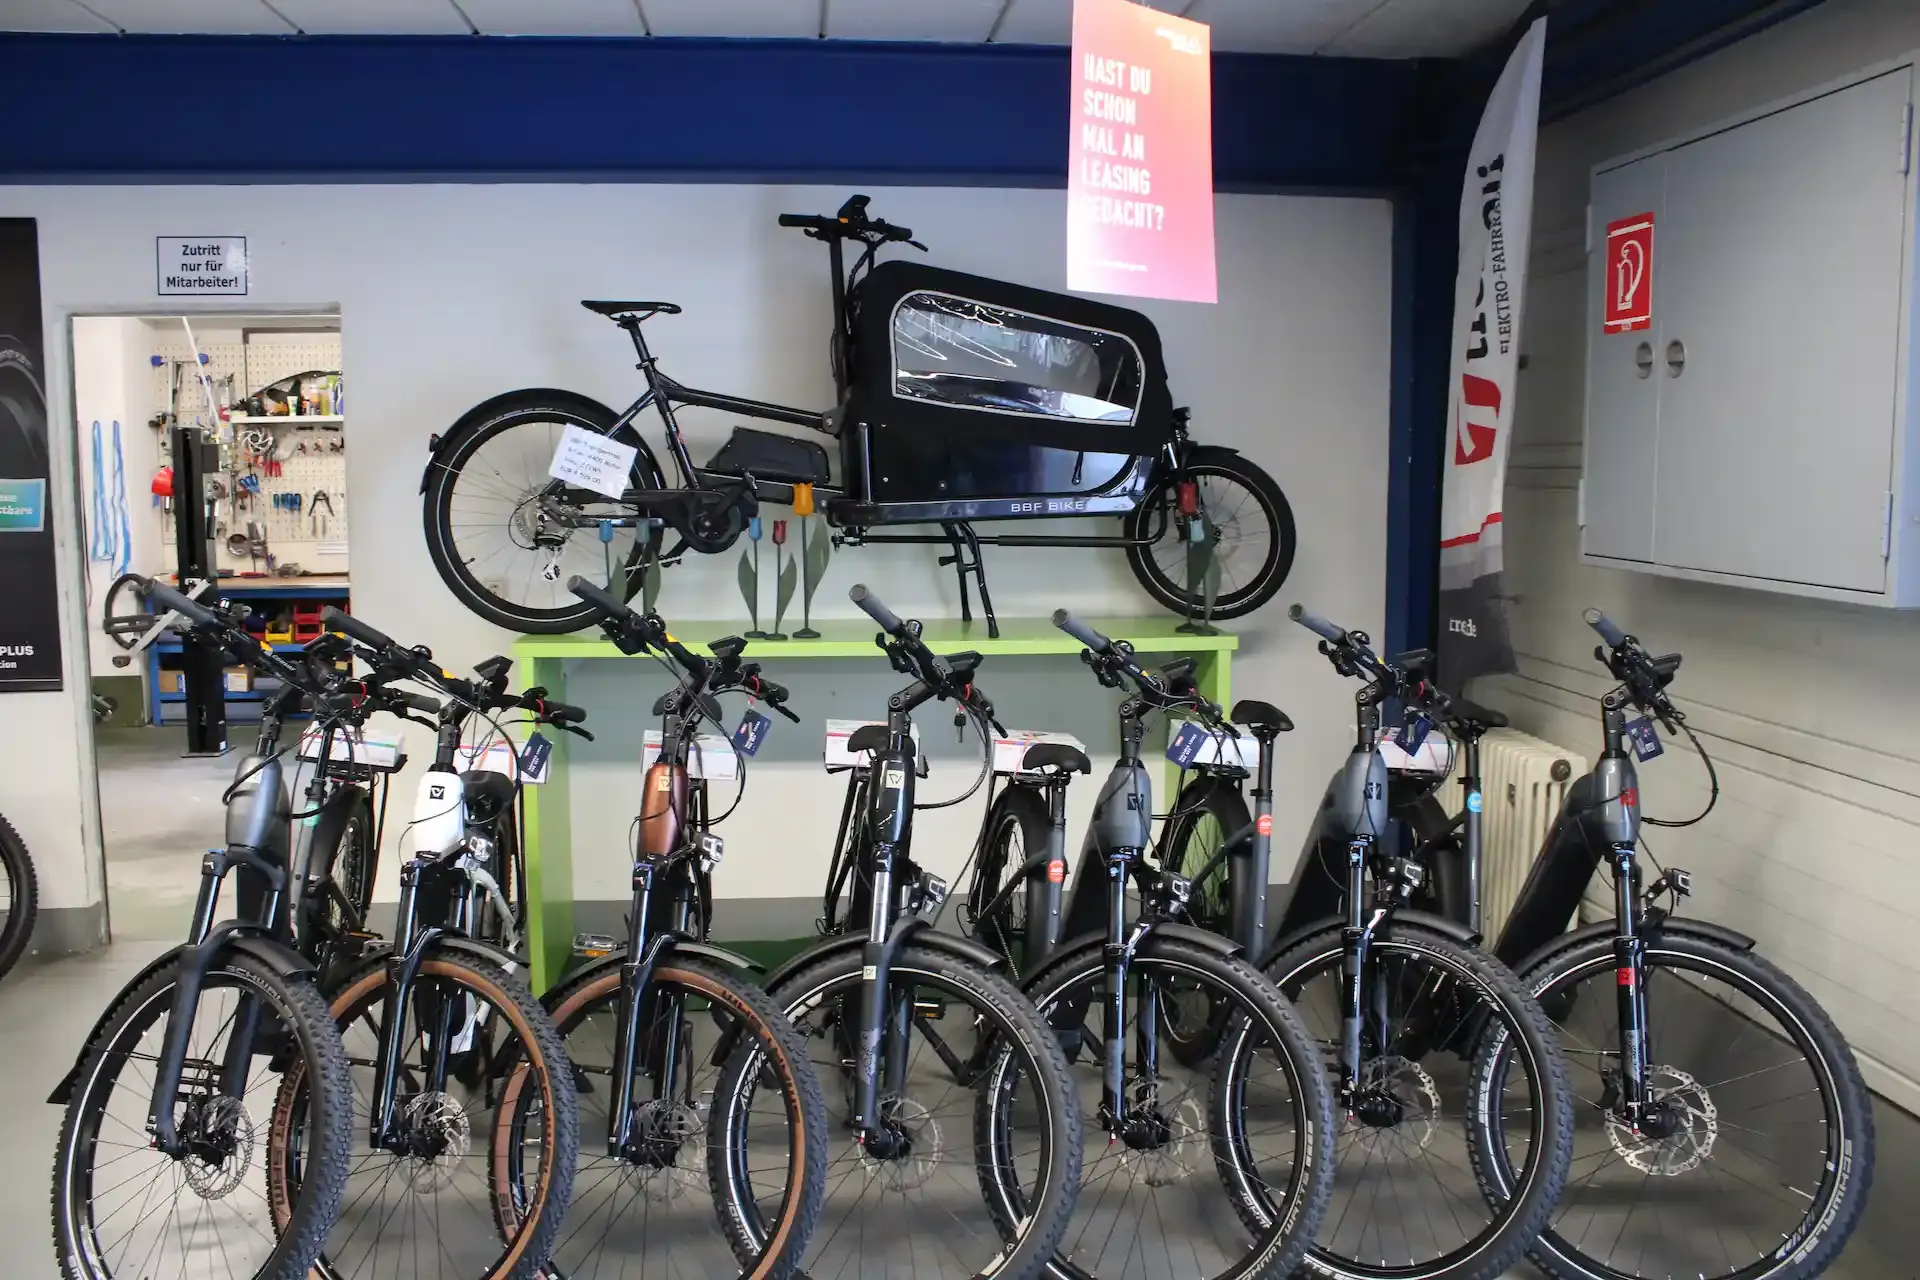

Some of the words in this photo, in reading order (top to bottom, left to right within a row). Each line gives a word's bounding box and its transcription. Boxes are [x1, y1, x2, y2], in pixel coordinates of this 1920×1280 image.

[1084, 53, 1126, 90] HAST
[1129, 65, 1151, 95] DU
[1083, 88, 1137, 125] SCHON
[1082, 124, 1118, 156] MAL
[1121, 132, 1145, 161] AN
[1081, 158, 1151, 196] LEASING
[182, 244, 221, 256] Zutritt
[181, 263, 202, 272] nur
[205, 260, 223, 272] für
[166, 276, 238, 288] Mitarbeiter!
[1011, 502, 1043, 512] BBF
[1048, 501, 1085, 511] BIKE
